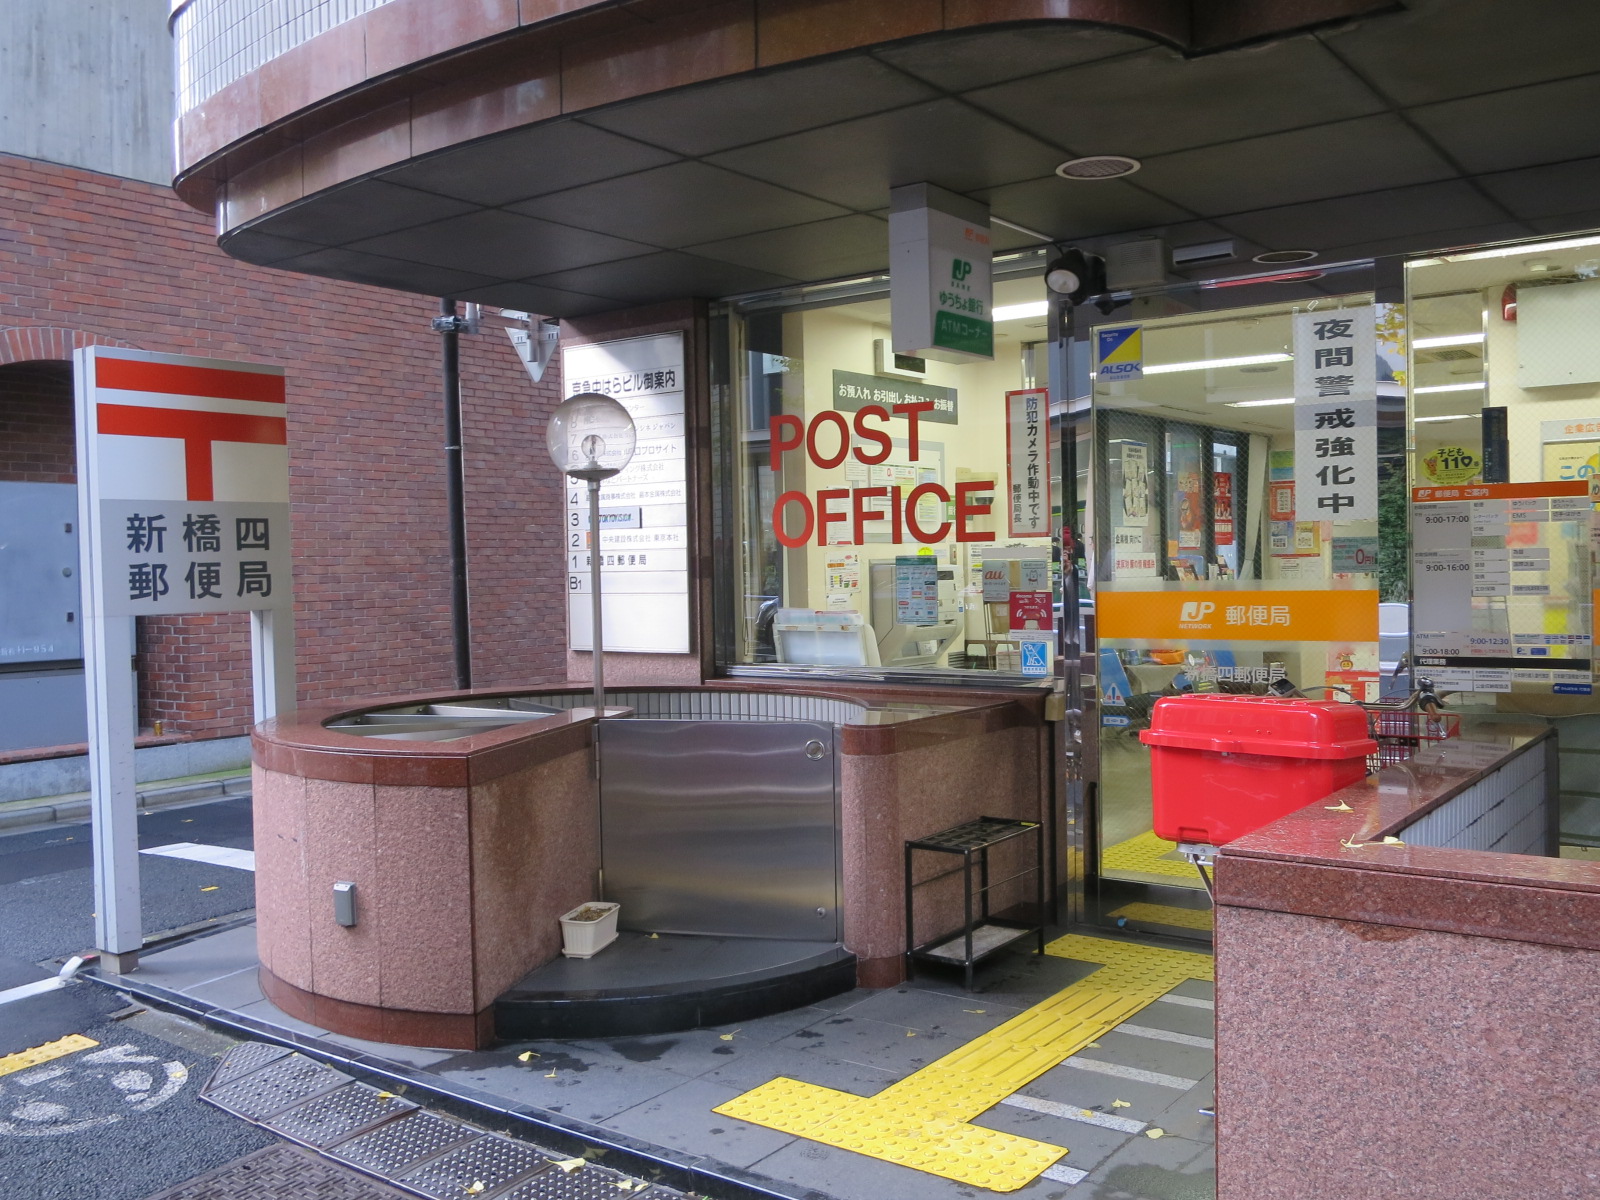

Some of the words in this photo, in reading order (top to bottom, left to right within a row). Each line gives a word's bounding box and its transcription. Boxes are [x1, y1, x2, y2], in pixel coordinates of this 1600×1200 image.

[938, 291, 984, 315] ゆうちょ銀行
[941, 319, 988, 338] ATMコーナー
[1100, 362, 1141, 375] ALSOK
[838, 383, 872, 400] お預入れ
[873, 388, 903, 404] お引出し
[933, 398, 955, 412] お振替
[1313, 318, 1356, 514] 夜間警戒強化中
[769, 401, 934, 472] POST
[571, 449, 580, 461] 6
[1437, 448, 1465, 458] 子ども
[1026, 397, 1041, 529] 防犯カメラ作動中です
[570, 492, 579, 506] 4
[1464, 487, 1489, 497] ご案内
[1012, 484, 1023, 523] 郵便局長
[571, 512, 580, 527] 3
[772, 481, 995, 548] OFFICE
[1425, 515, 1470, 524] 9:00-17:00
[126, 513, 270, 554] 新橋四
[572, 533, 580, 547] 2
[571, 555, 578, 569] 1
[1425, 563, 1470, 572] 9:00-16:00
[128, 560, 273, 602] 郵便局
[984, 570, 1005, 580] au
[570, 576, 582, 590] B1
[1180, 601, 1216, 622] JP
[1225, 605, 1291, 627] 郵便局
[1469, 637, 1510, 645] 9:00-12:30
[1422, 648, 1460, 656] 9:00-18:00
[1184, 666, 1287, 684] 新橋四郵便局
